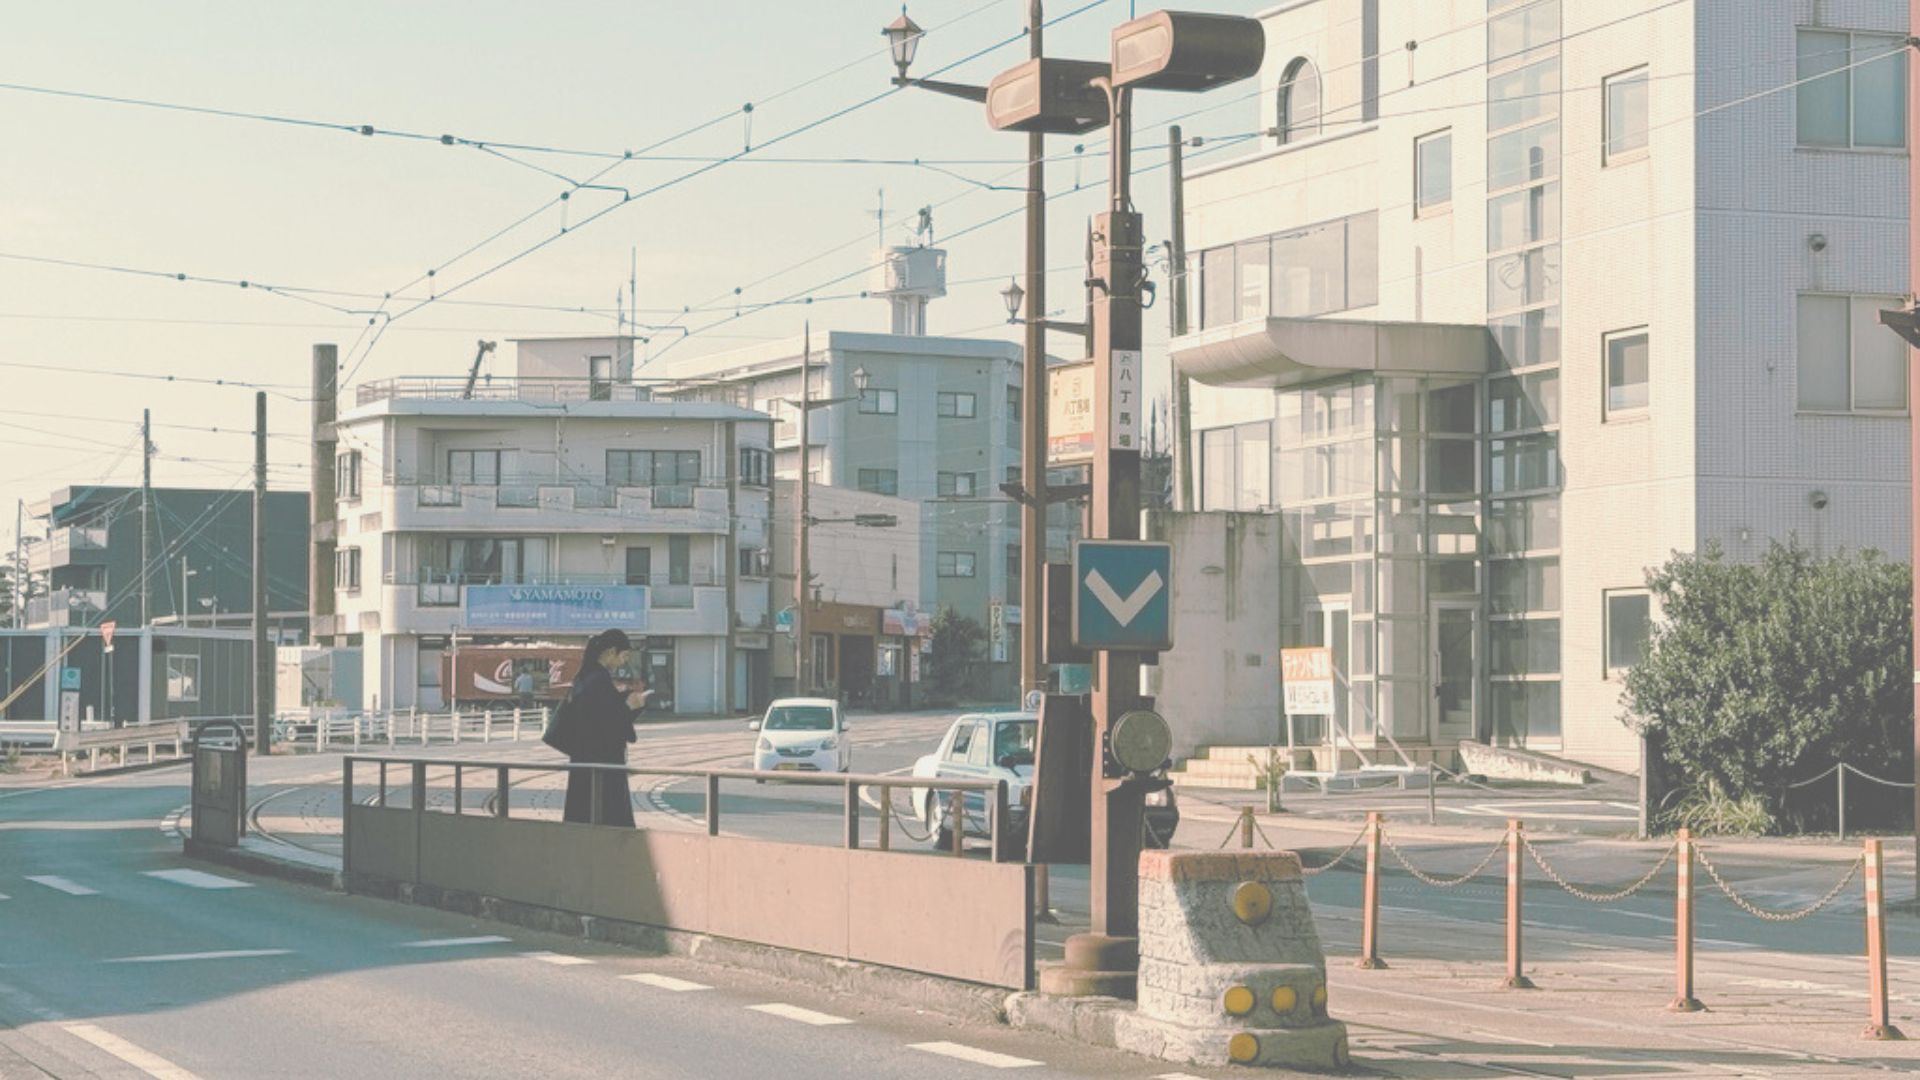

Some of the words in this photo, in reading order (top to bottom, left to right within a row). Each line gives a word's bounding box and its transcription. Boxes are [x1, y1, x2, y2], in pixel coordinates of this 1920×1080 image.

[1119, 368, 1132, 447] 八丁馬場
[523, 588, 603, 601] YAMAMOTO
